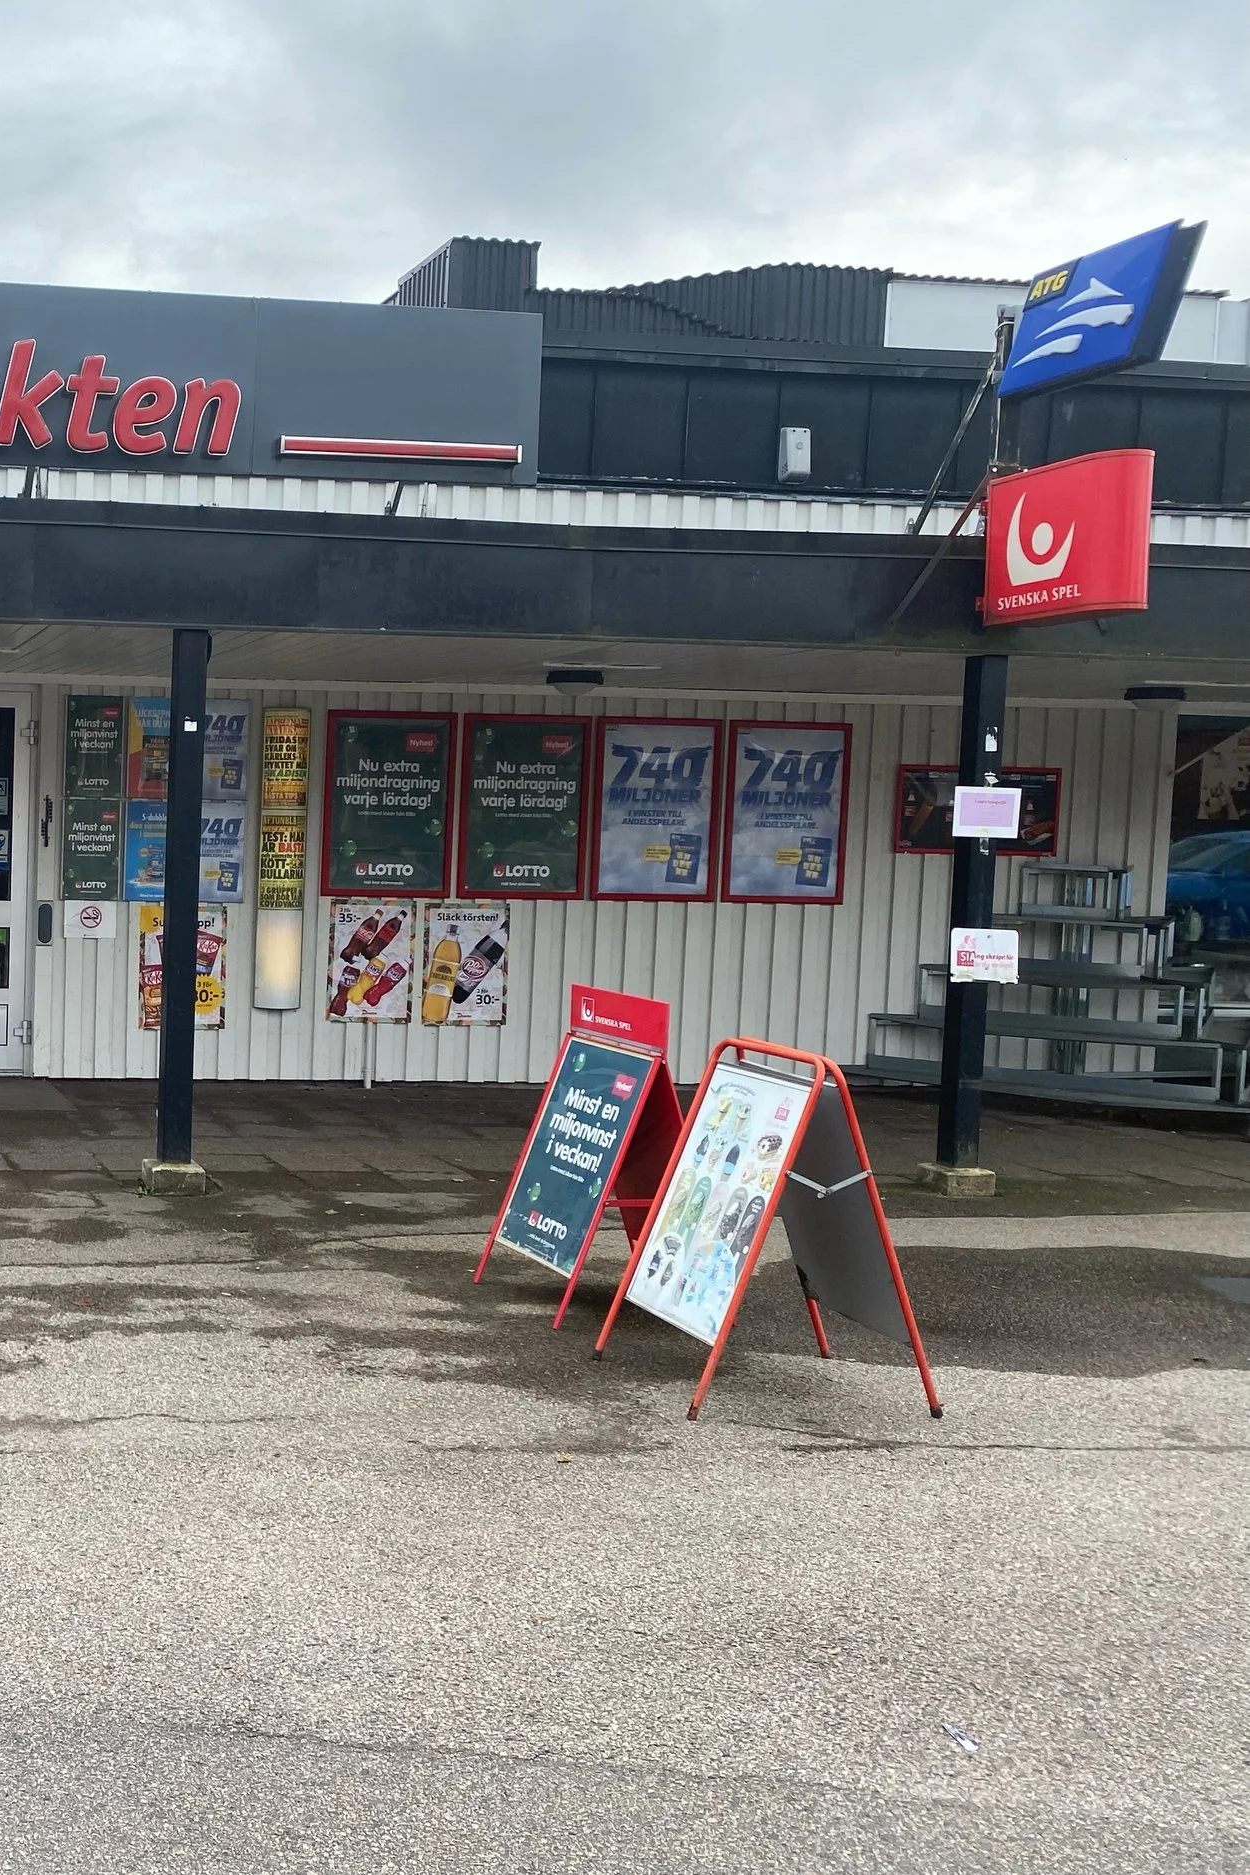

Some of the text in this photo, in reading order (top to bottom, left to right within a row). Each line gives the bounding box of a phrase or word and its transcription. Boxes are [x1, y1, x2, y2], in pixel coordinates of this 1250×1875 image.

[1029, 270, 1069, 301] ATG
[998, 584, 1081, 611] SVENSKA SPEL
[75, 719, 114, 728] Minst en
[71, 728, 119, 739] miljonvinst
[206, 735, 242, 743] ILJONER
[80, 739, 114, 749] veckan!
[358, 759, 420, 773] Nu extra
[496, 761, 556, 775] Nu extra
[612, 743, 711, 788] 740
[744, 746, 843, 791] 740
[336, 775, 441, 793] miljondragning
[473, 776, 577, 794] miljondragning
[344, 792, 431, 810] varje lördag!
[481, 794, 567, 811] varje lördag!
[609, 788, 701, 804] MILJONER
[741, 791, 832, 807] MILJONER
[635, 810, 666, 818] VINSTER
[668, 810, 682, 818] TILL
[73, 822, 98, 831] Minst
[68, 832, 116, 843] miljonvinst
[201, 838, 239, 846] ILJONER
[262, 832, 287, 842] TEST:
[77, 842, 111, 852] veckan!
[368, 864, 414, 877] LOTTO
[505, 865, 550, 878] LOTTO
[339, 913, 361, 922] 35:-
[437, 913, 499, 922] Släck törsten!
[961, 952, 975, 961] SIA
[476, 995, 500, 1005] 30:-
[595, 1016, 632, 1031] SVENSKA SPEL
[564, 1087, 620, 1122] Minst en
[550, 1112, 617, 1149] miljonvinst
[546, 1133, 604, 1173] i veckan!
[537, 1214, 568, 1240] LOTTO
